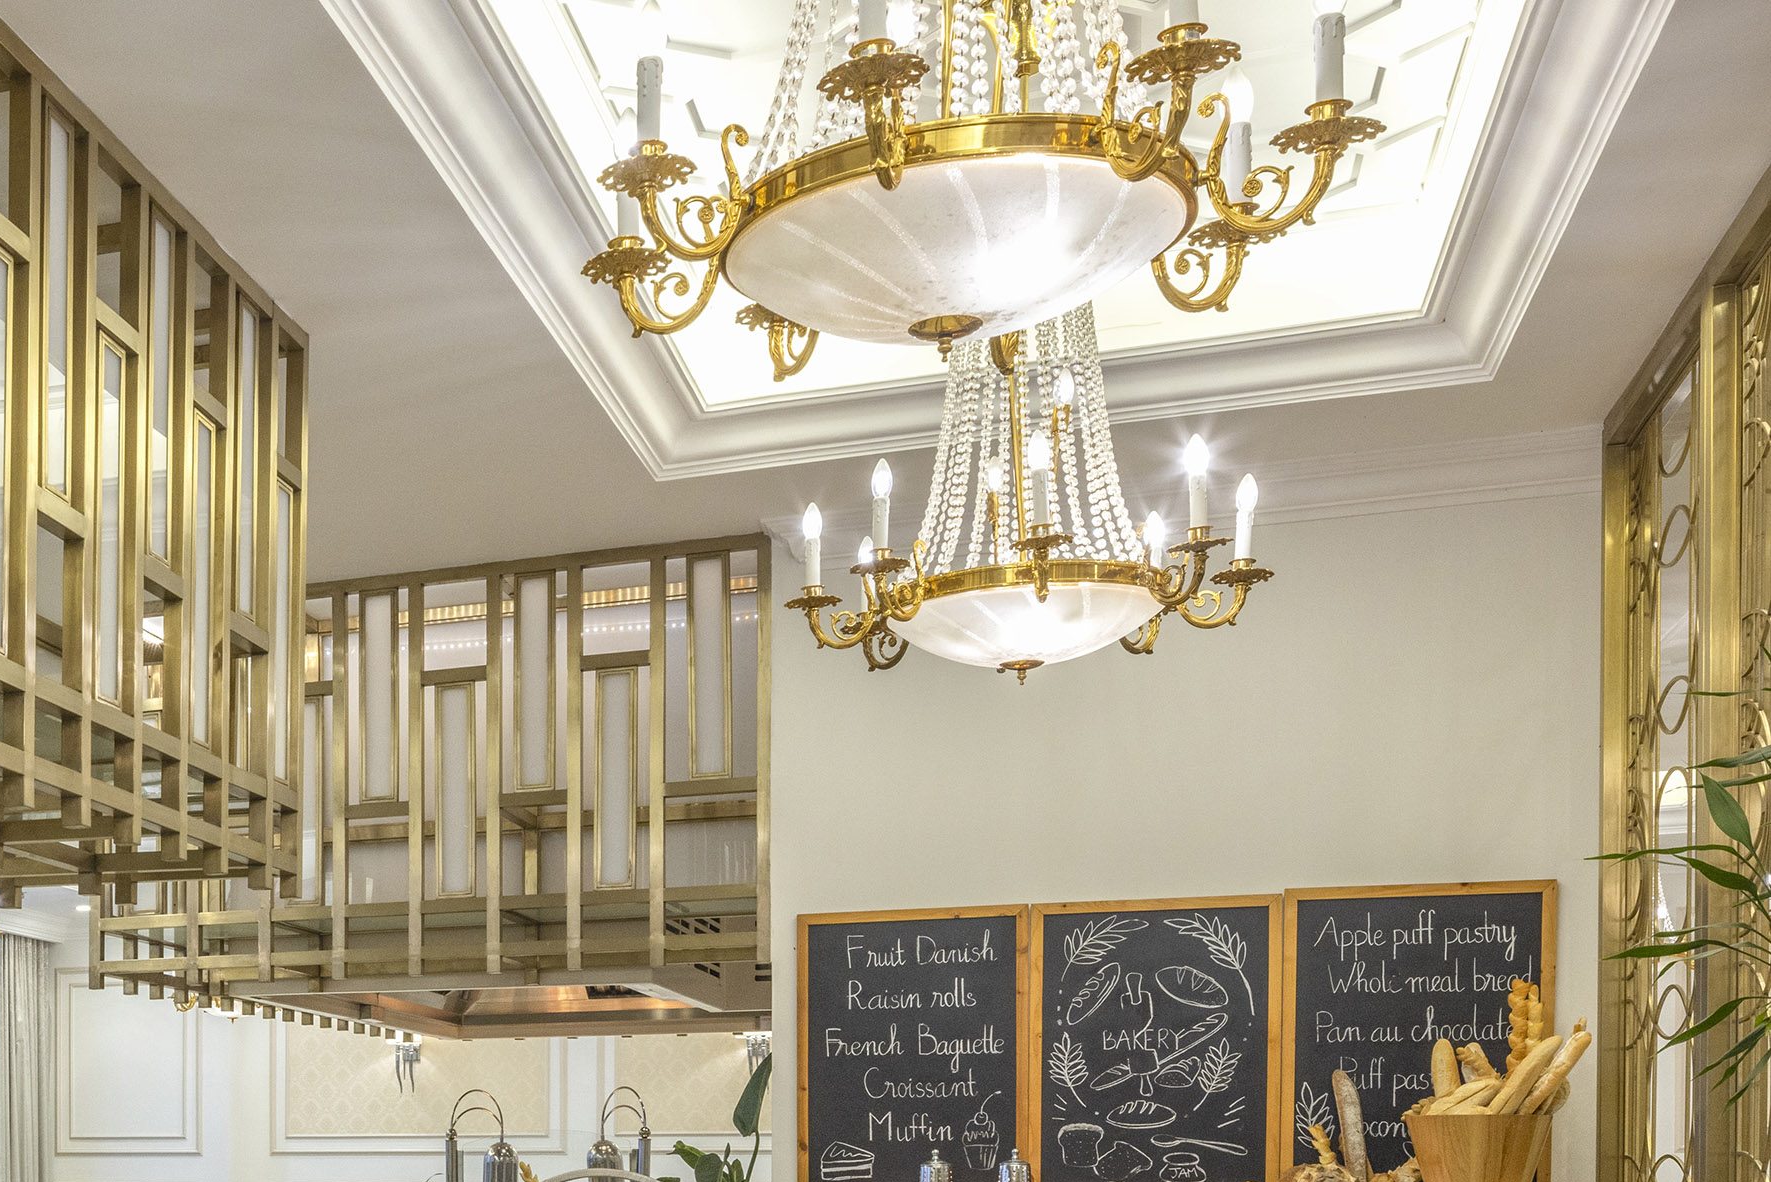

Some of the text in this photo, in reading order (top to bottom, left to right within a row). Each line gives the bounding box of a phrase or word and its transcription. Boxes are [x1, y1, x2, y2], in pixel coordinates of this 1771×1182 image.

[846, 929, 997, 968] Fruit Danish
[1314, 909, 1518, 961] Apple puff pastry
[1405, 958, 1465, 993] meal
[846, 977, 977, 1010] Raisin rolls
[1103, 1028, 1185, 1050] BAKERY
[1316, 1011, 1366, 1043] Pan
[1370, 1026, 1404, 1042] au
[825, 1023, 1005, 1073] French Baguette
[864, 1066, 978, 1098] Croissant
[868, 1111, 954, 1142] Muffin
[1169, 1167, 1198, 1178] JAM
